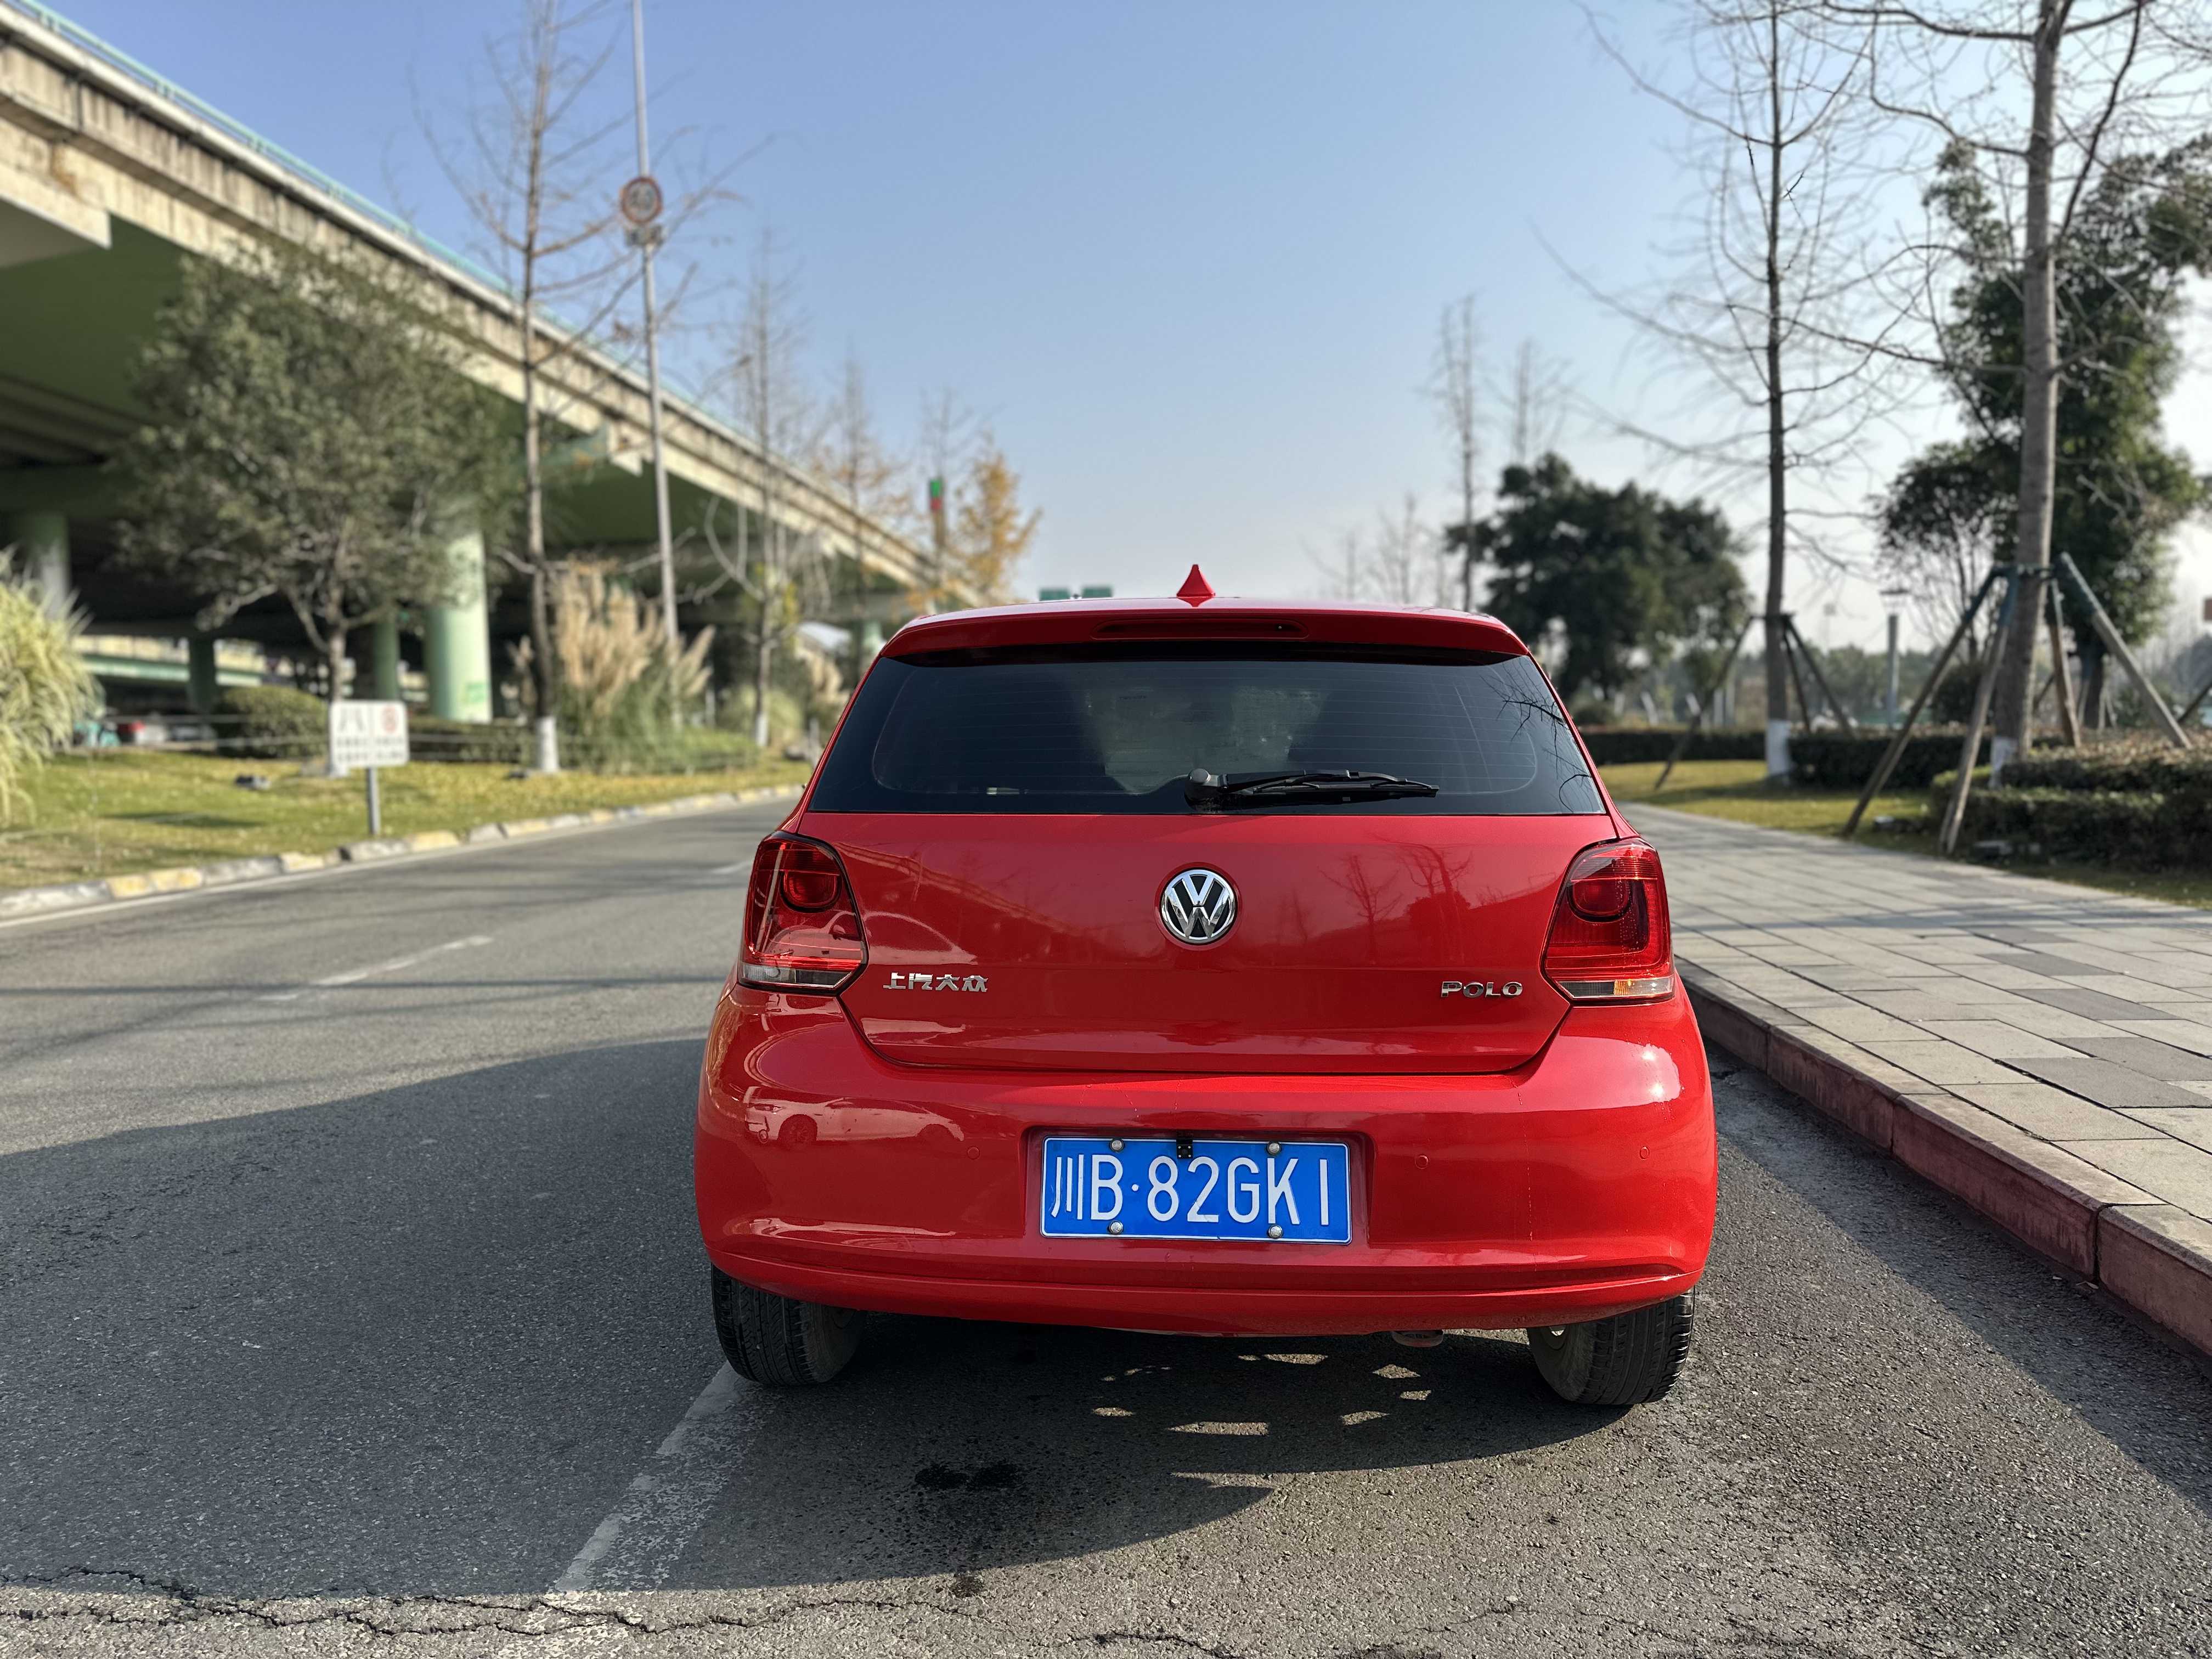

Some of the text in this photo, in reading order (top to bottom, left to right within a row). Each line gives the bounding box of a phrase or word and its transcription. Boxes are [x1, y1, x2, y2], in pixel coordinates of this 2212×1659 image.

[1161, 870, 1235, 944] VW
[883, 972, 988, 992] 上汽大众
[1441, 981, 1523, 998] POLO
